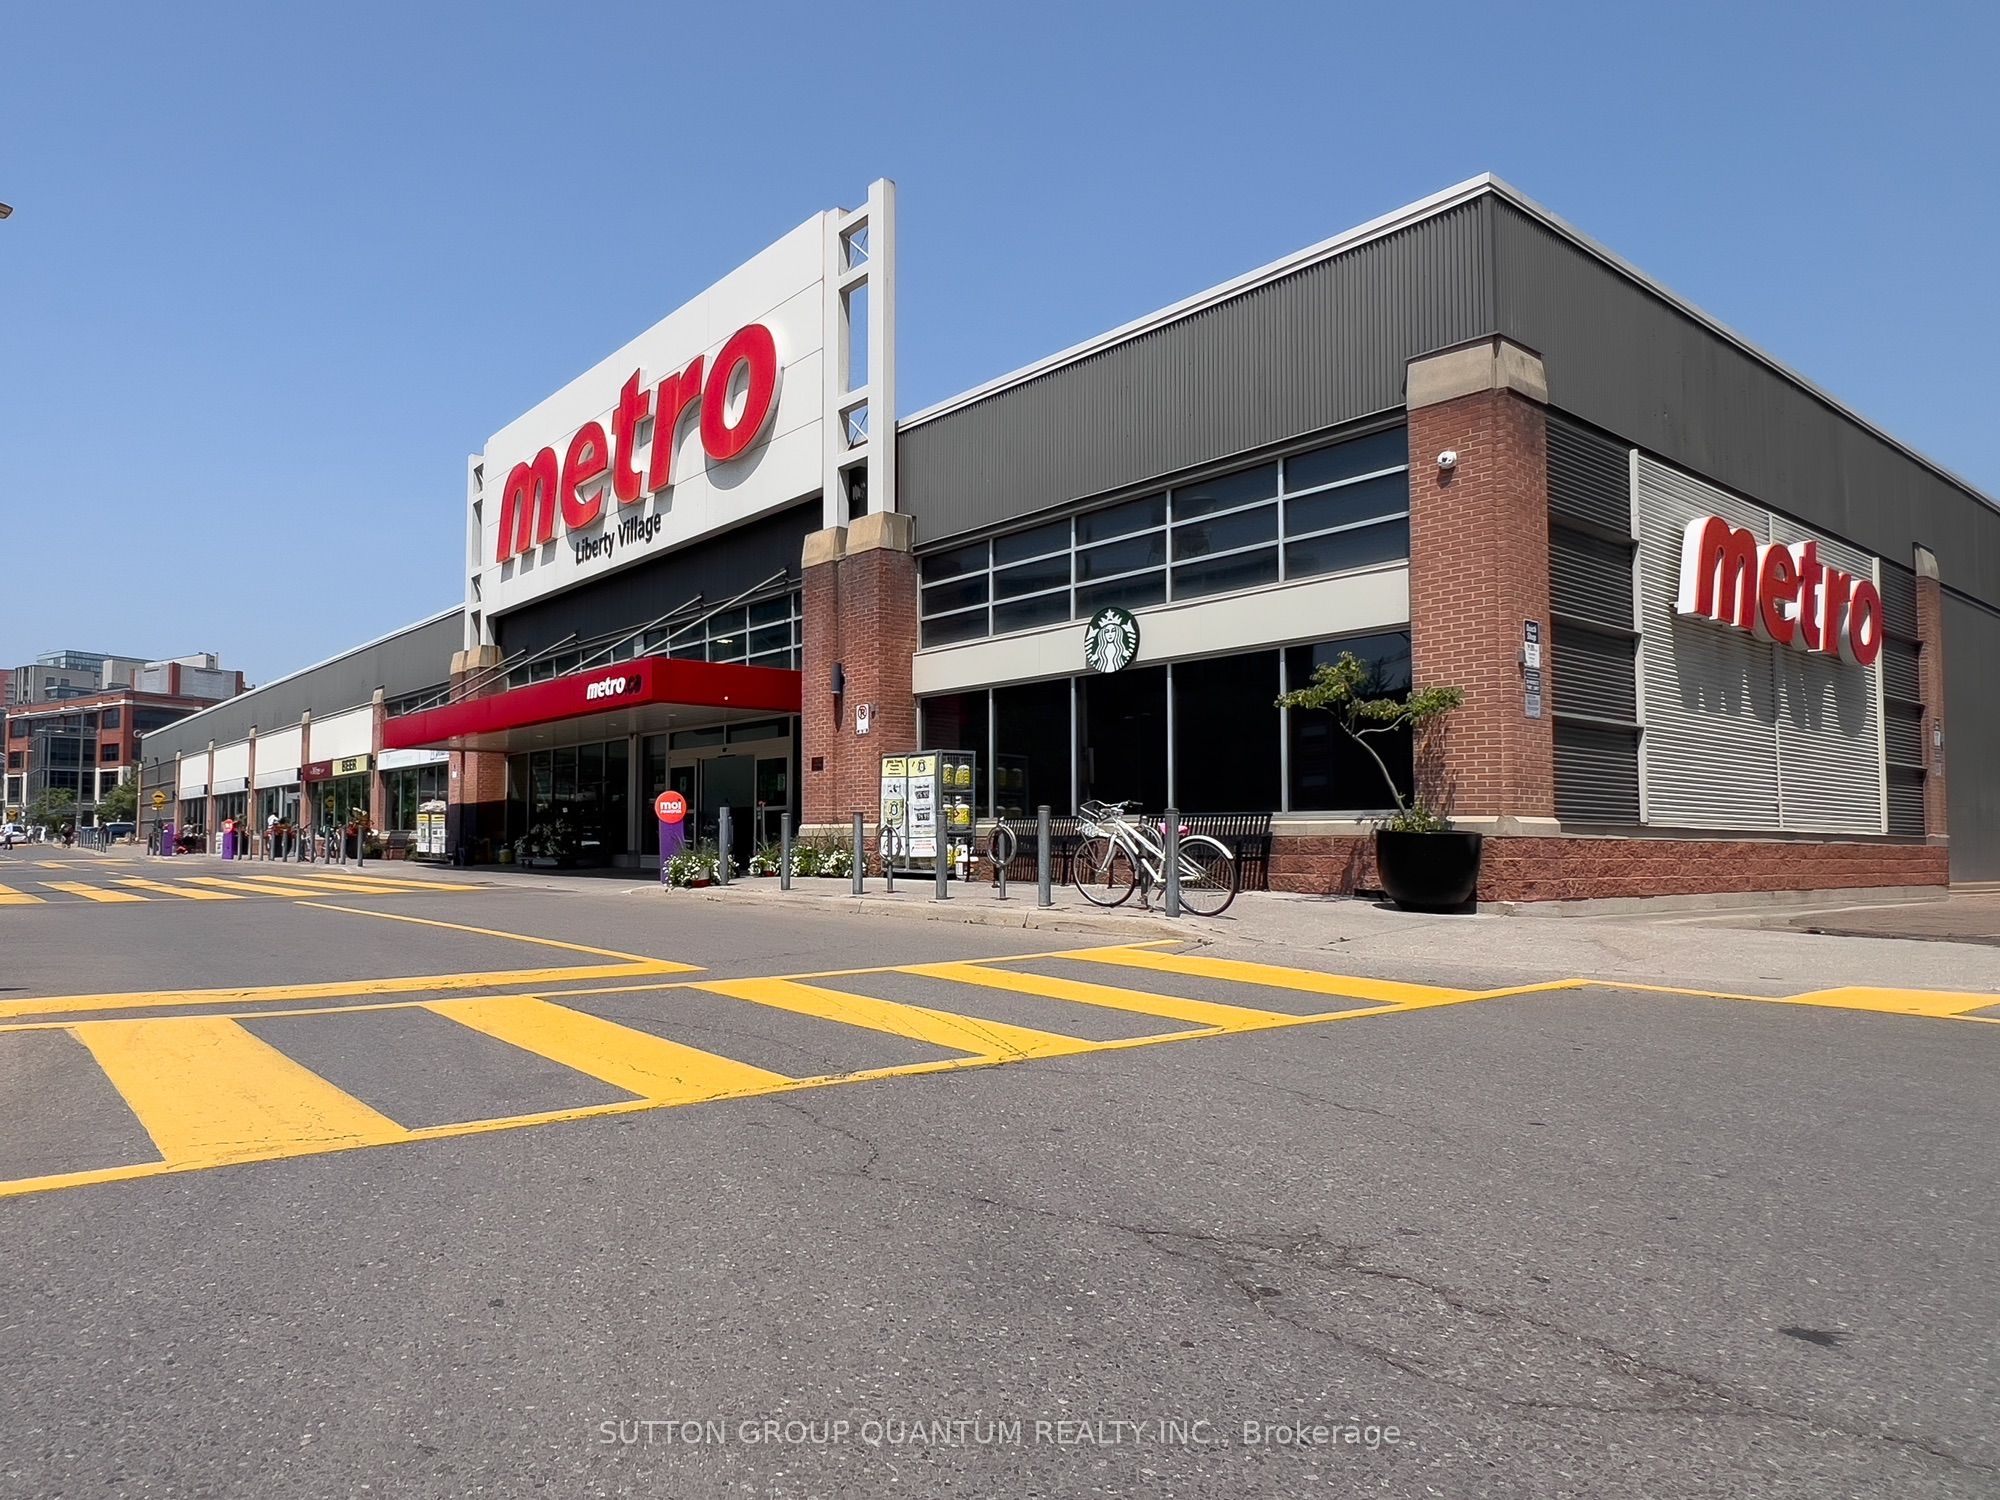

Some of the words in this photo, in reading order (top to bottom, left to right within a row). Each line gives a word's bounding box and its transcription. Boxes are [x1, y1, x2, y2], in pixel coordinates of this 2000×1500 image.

[496, 323, 779, 564] metro
[575, 532, 615, 566] Liberty
[617, 513, 662, 548] Village
[1677, 515, 1882, 667] metro
[660, 798, 682, 810] moi
